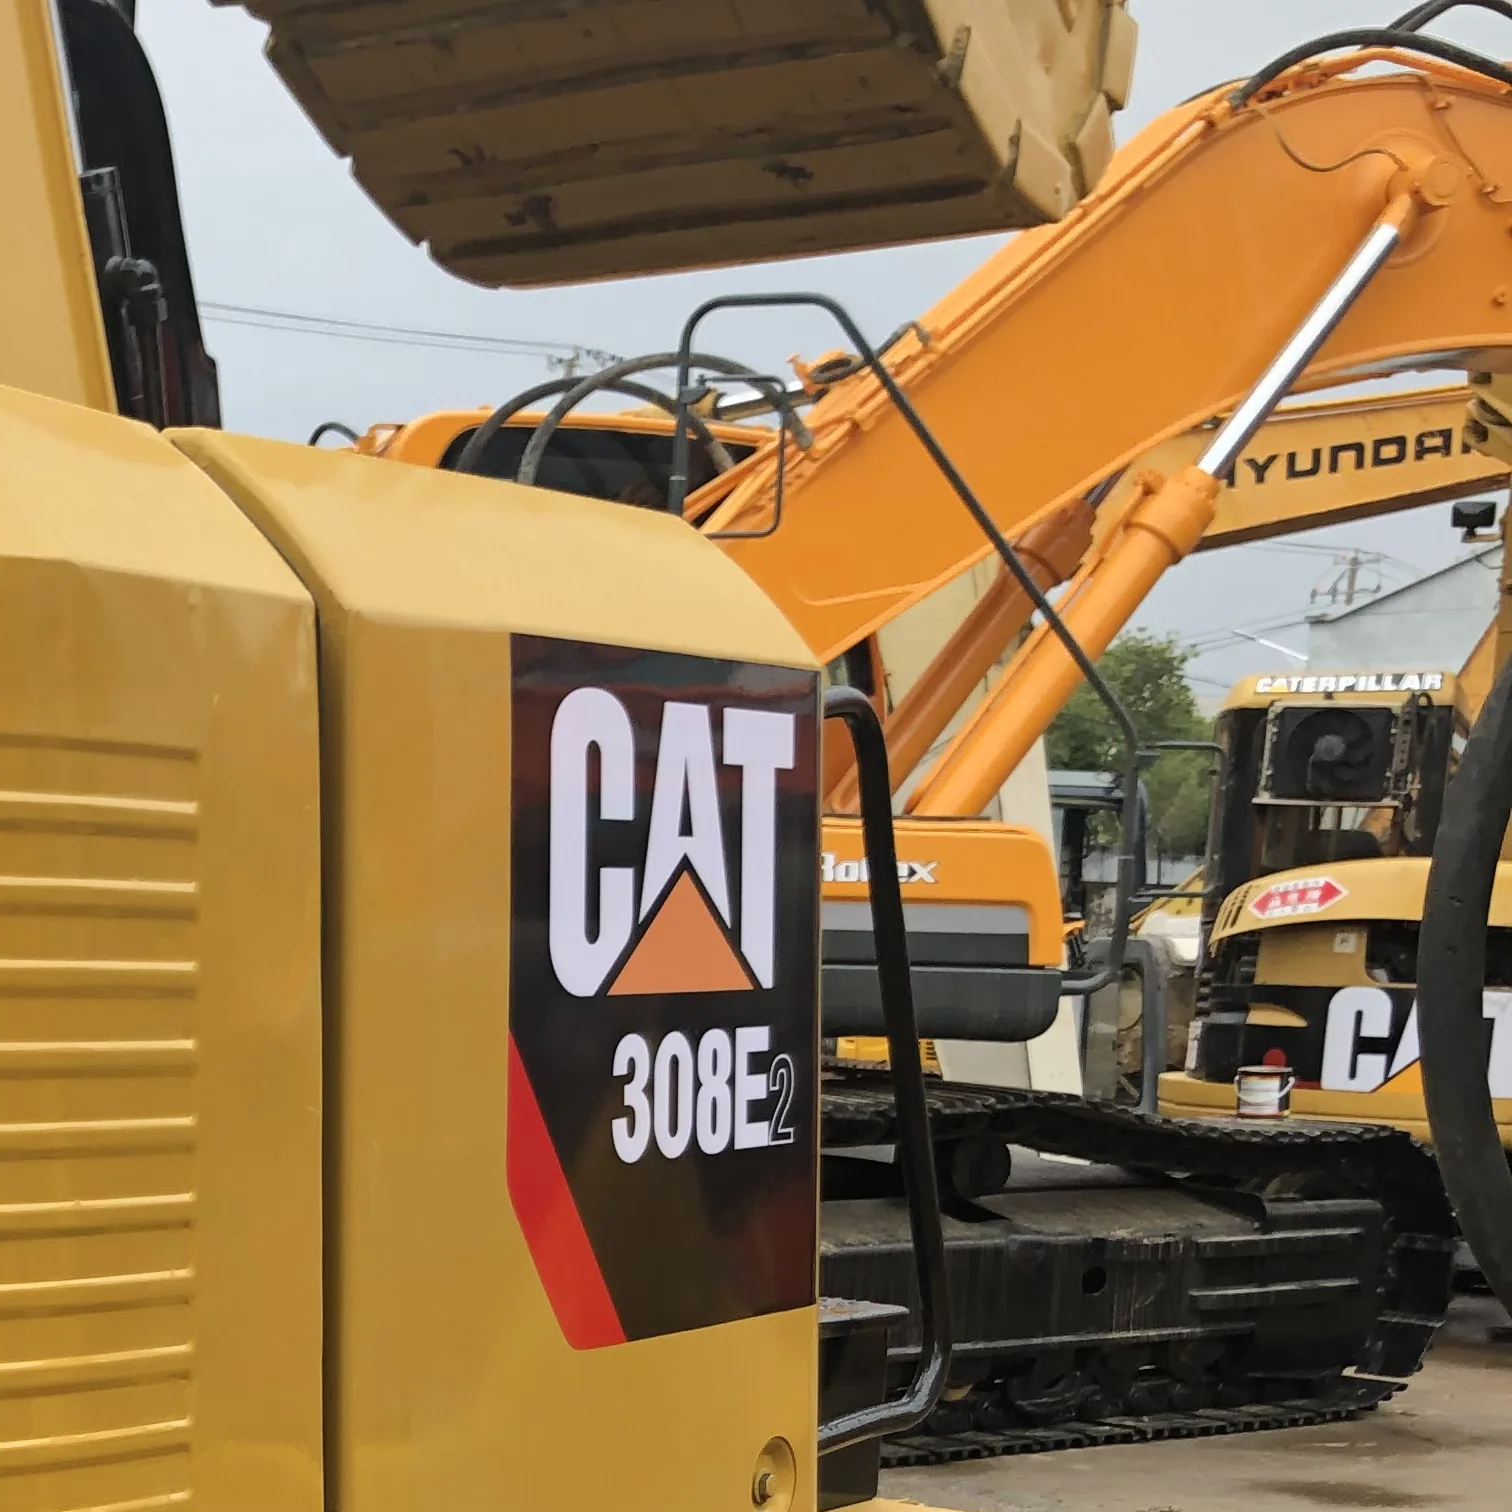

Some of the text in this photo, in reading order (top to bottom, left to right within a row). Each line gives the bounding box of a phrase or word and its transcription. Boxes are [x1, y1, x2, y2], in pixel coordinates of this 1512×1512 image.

[1256, 673, 1443, 693] CATERPILLAR
[548, 685, 797, 998] CAT
[610, 1026, 796, 1165] 308E2
